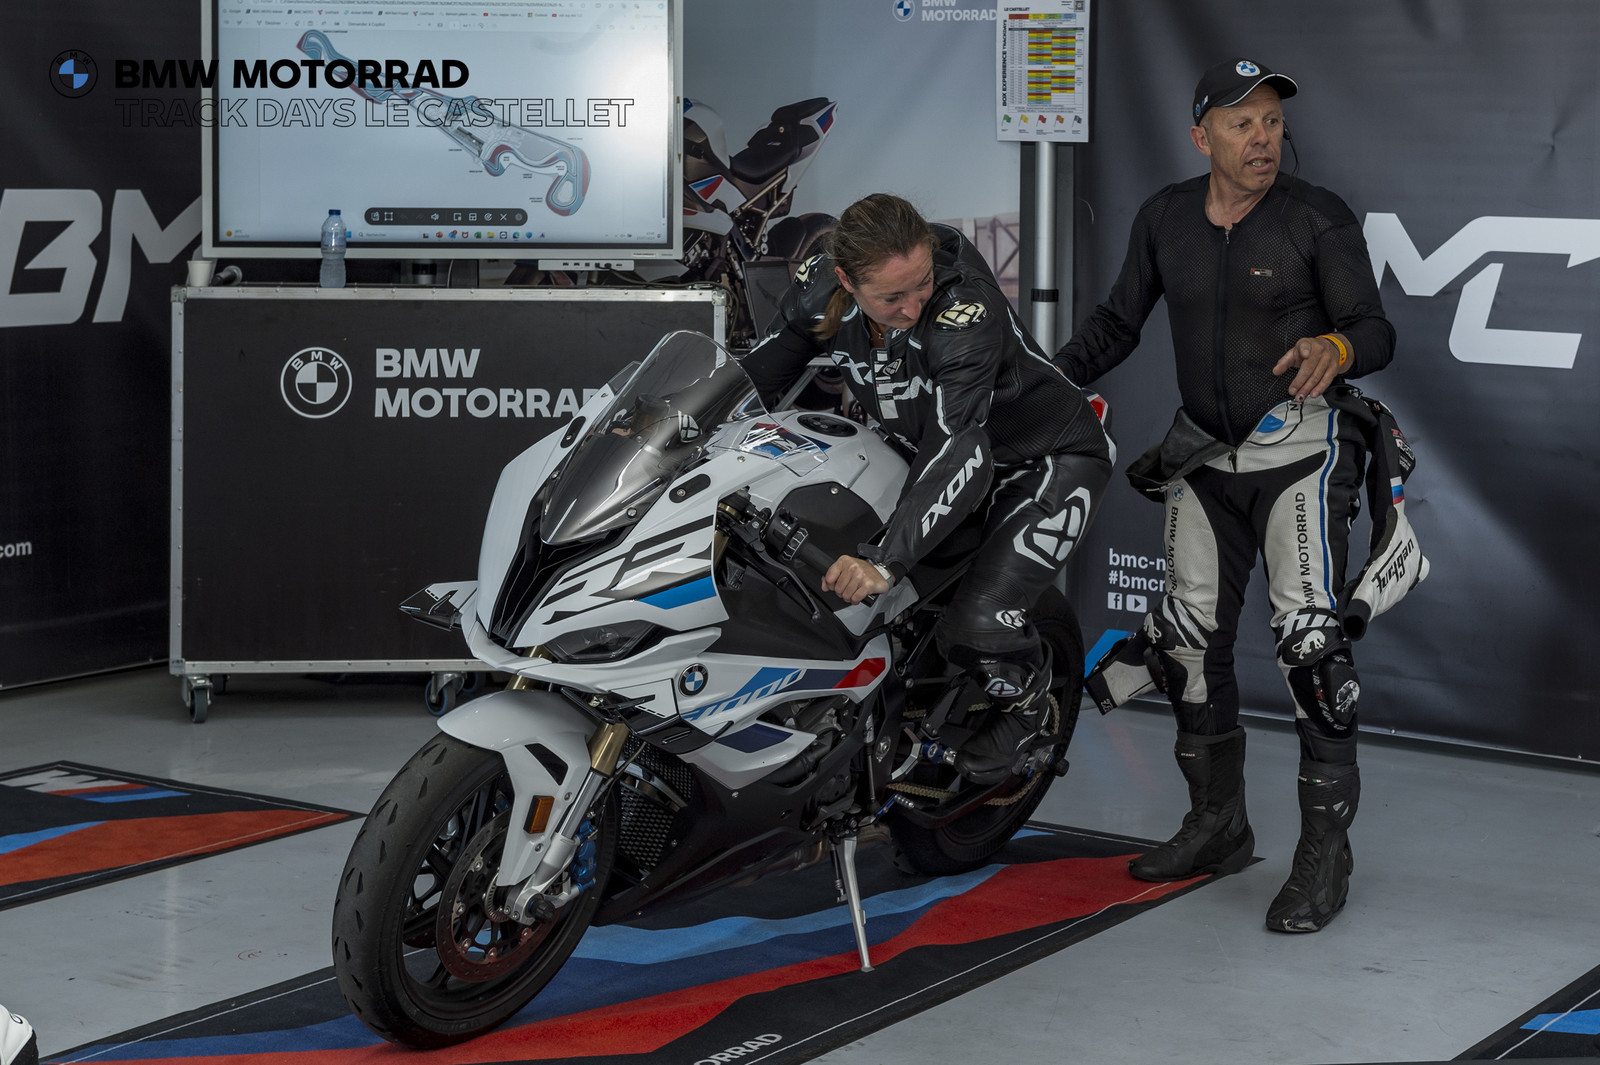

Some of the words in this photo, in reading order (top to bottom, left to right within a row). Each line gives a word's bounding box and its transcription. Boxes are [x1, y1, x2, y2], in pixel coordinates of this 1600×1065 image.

[922, 9, 997, 21] MOTORRAD
[0, 188, 216, 328] BM
[291, 350, 343, 371] BMW
[375, 348, 481, 378] BMW
[1170, 506, 1179, 543] BMW
[1295, 492, 1311, 576] MOTORRAD
